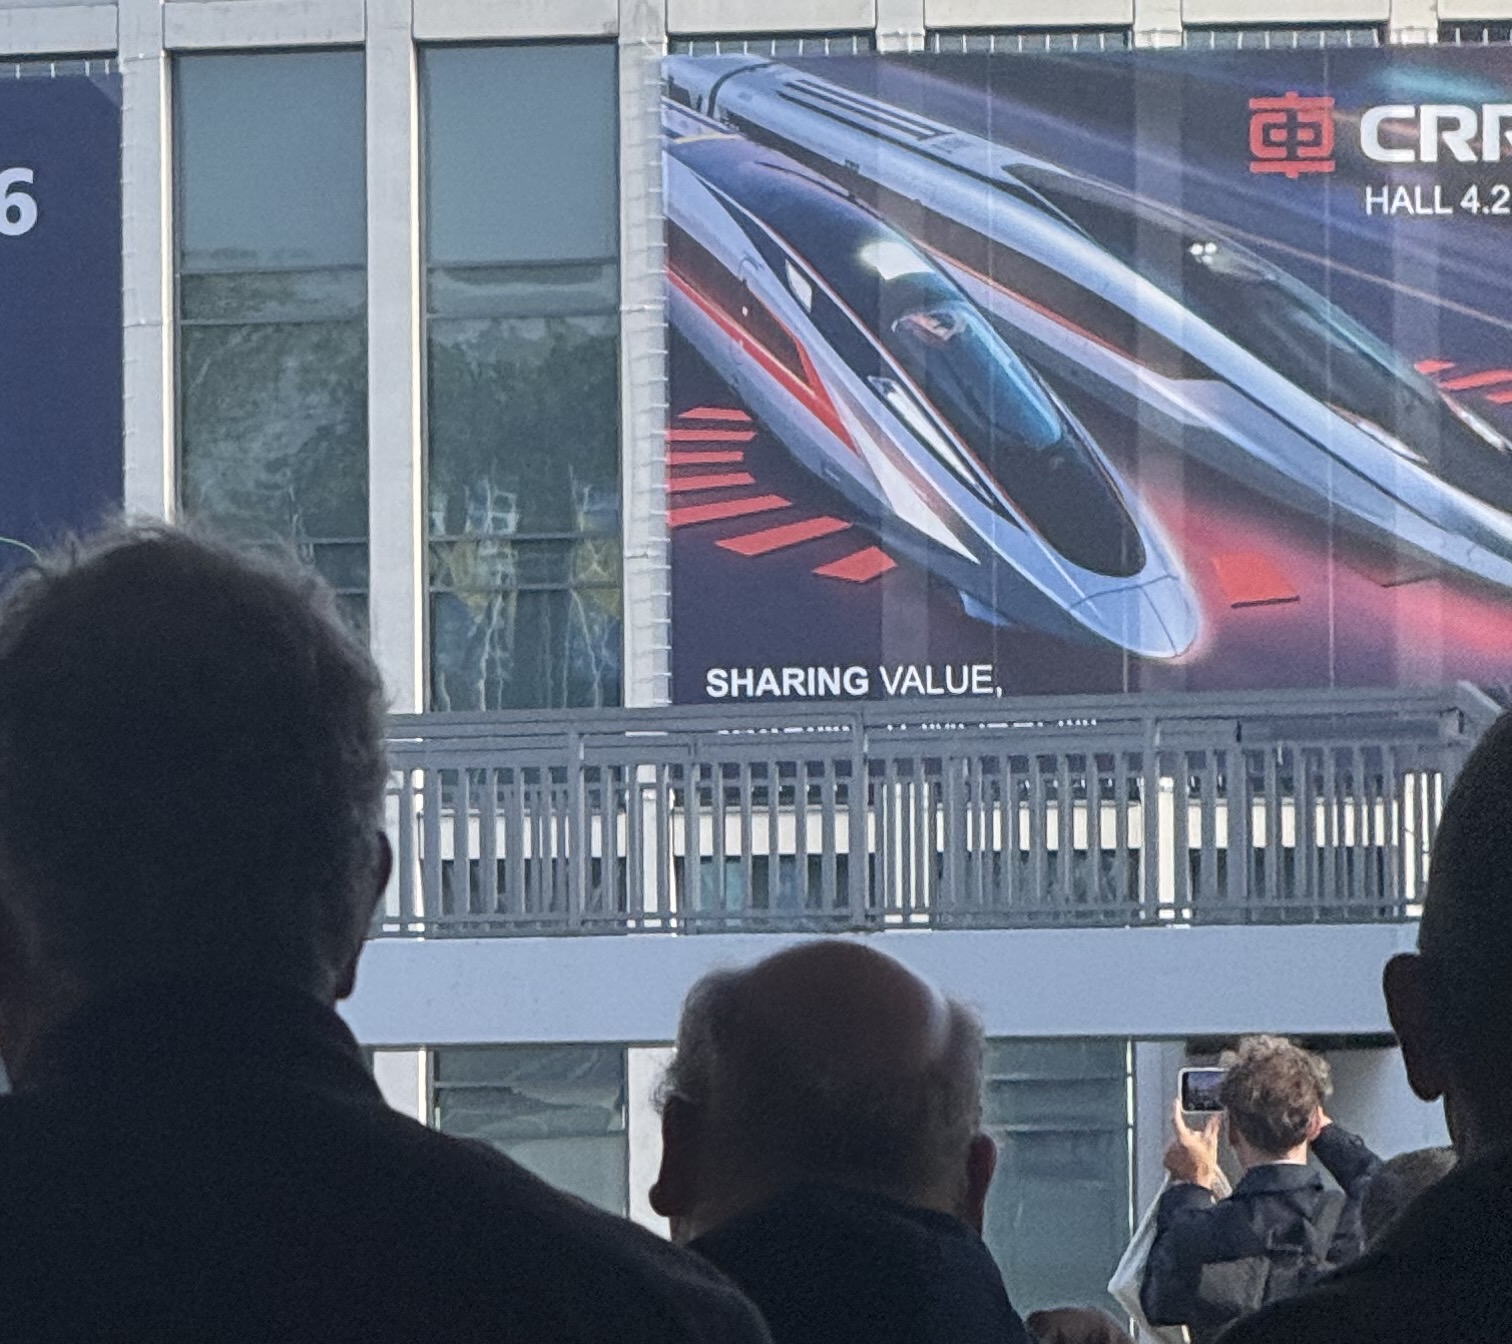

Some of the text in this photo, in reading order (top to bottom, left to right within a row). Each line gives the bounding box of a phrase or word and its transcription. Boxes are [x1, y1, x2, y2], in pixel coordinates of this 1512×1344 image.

[1365, 183, 1511, 216] HALL 4.2
[705, 664, 1004, 698] SHARING VALUE,
